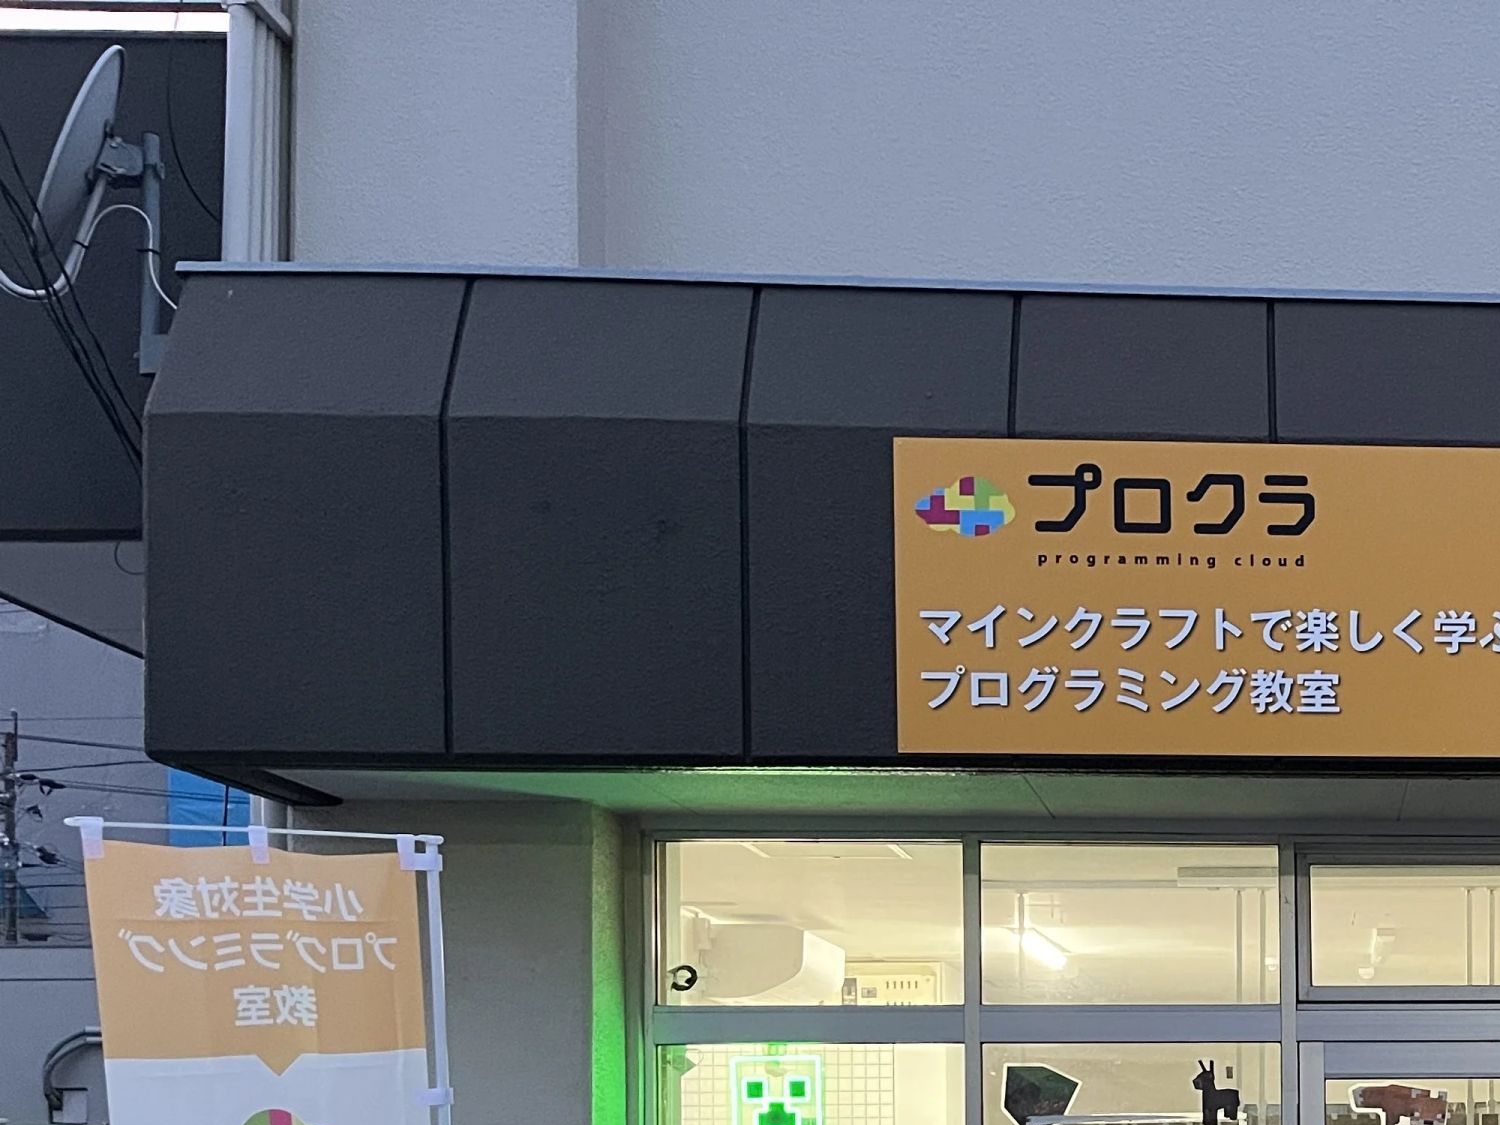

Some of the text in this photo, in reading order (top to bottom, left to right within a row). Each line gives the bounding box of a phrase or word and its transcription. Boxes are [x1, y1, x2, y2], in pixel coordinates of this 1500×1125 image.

[1027, 462, 1316, 536] プロクラ
[1037, 552, 1306, 569] programming cloud
[921, 665, 1342, 714] プログラミング教室
